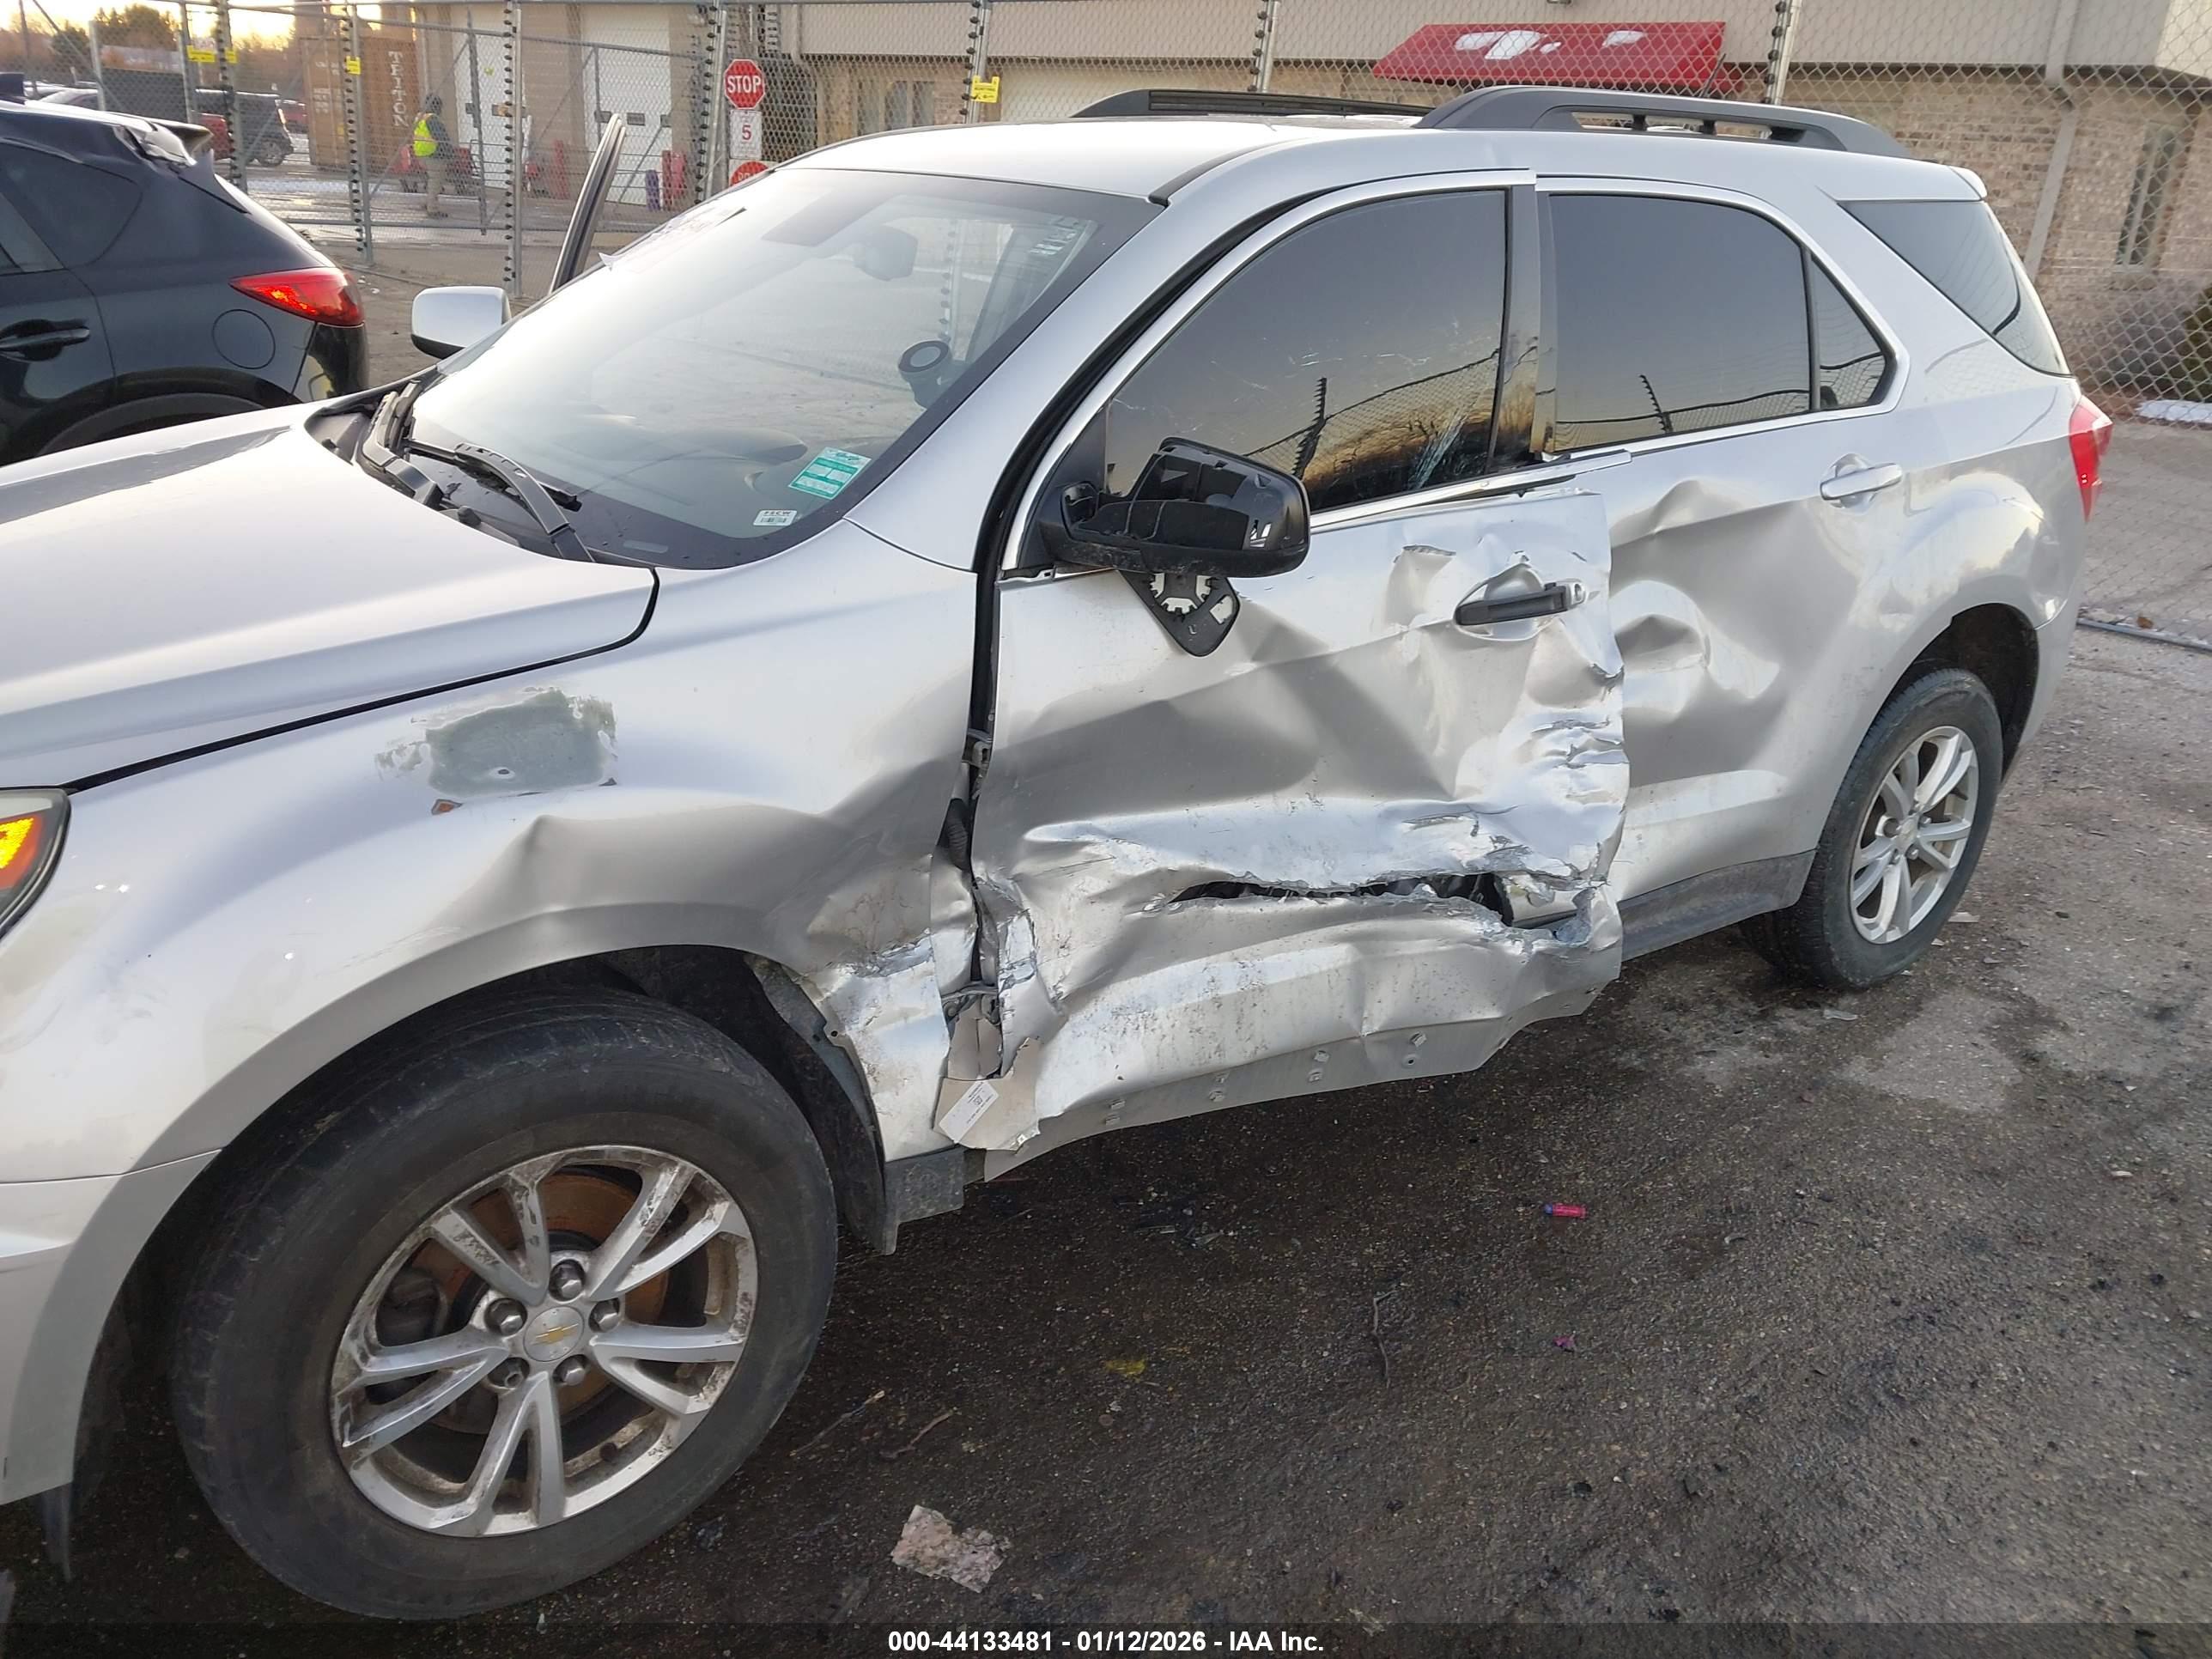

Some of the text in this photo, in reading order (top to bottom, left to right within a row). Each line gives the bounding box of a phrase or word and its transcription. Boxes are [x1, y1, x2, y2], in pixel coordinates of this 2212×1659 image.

[388, 51, 409, 127] TRITON
[727, 75, 762, 94] STOP
[741, 125, 752, 141] 5
